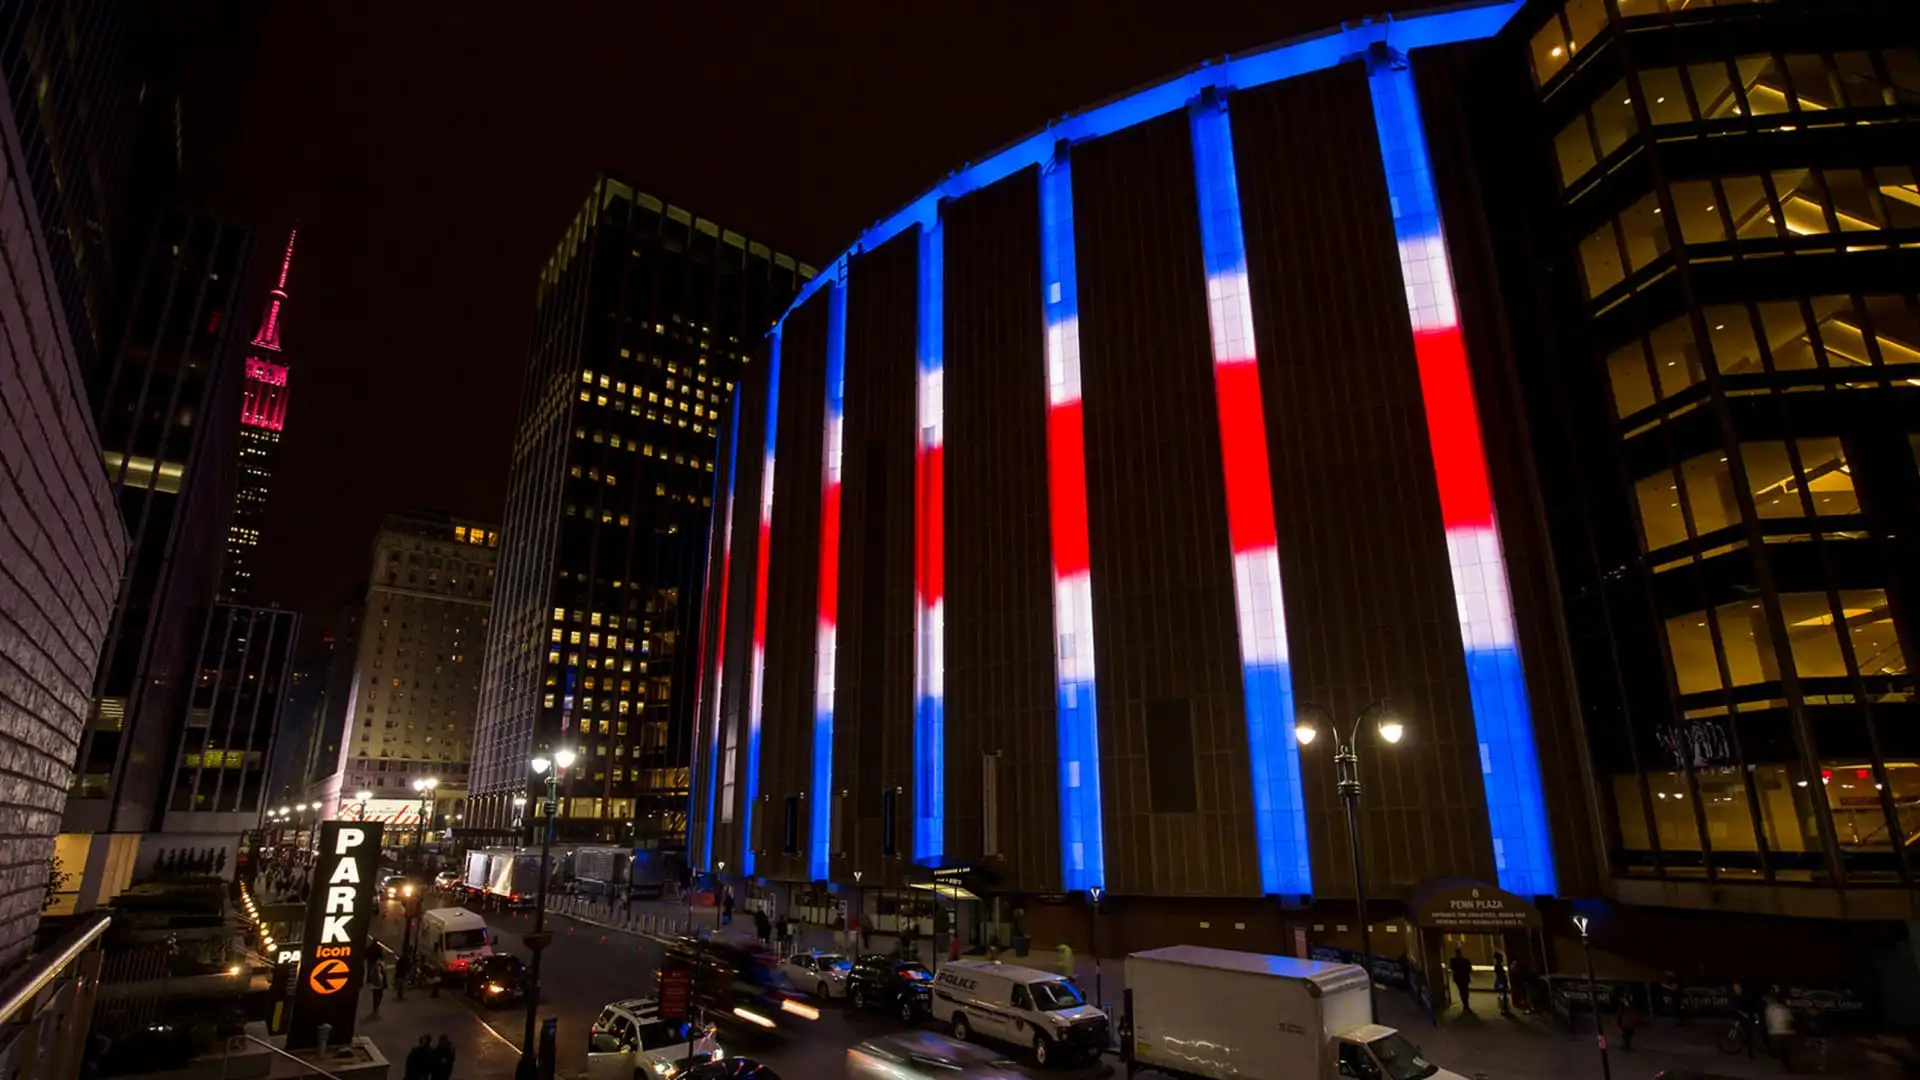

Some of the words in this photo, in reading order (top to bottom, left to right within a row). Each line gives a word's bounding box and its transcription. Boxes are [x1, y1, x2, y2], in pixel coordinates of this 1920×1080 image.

[321, 828, 365, 944] PARK
[1451, 900, 1474, 909] PENN
[1476, 900, 1502, 909] PLAZA
[278, 950, 302, 965] PA
[316, 945, 351, 958] icon
[938, 972, 978, 991] POLICE
